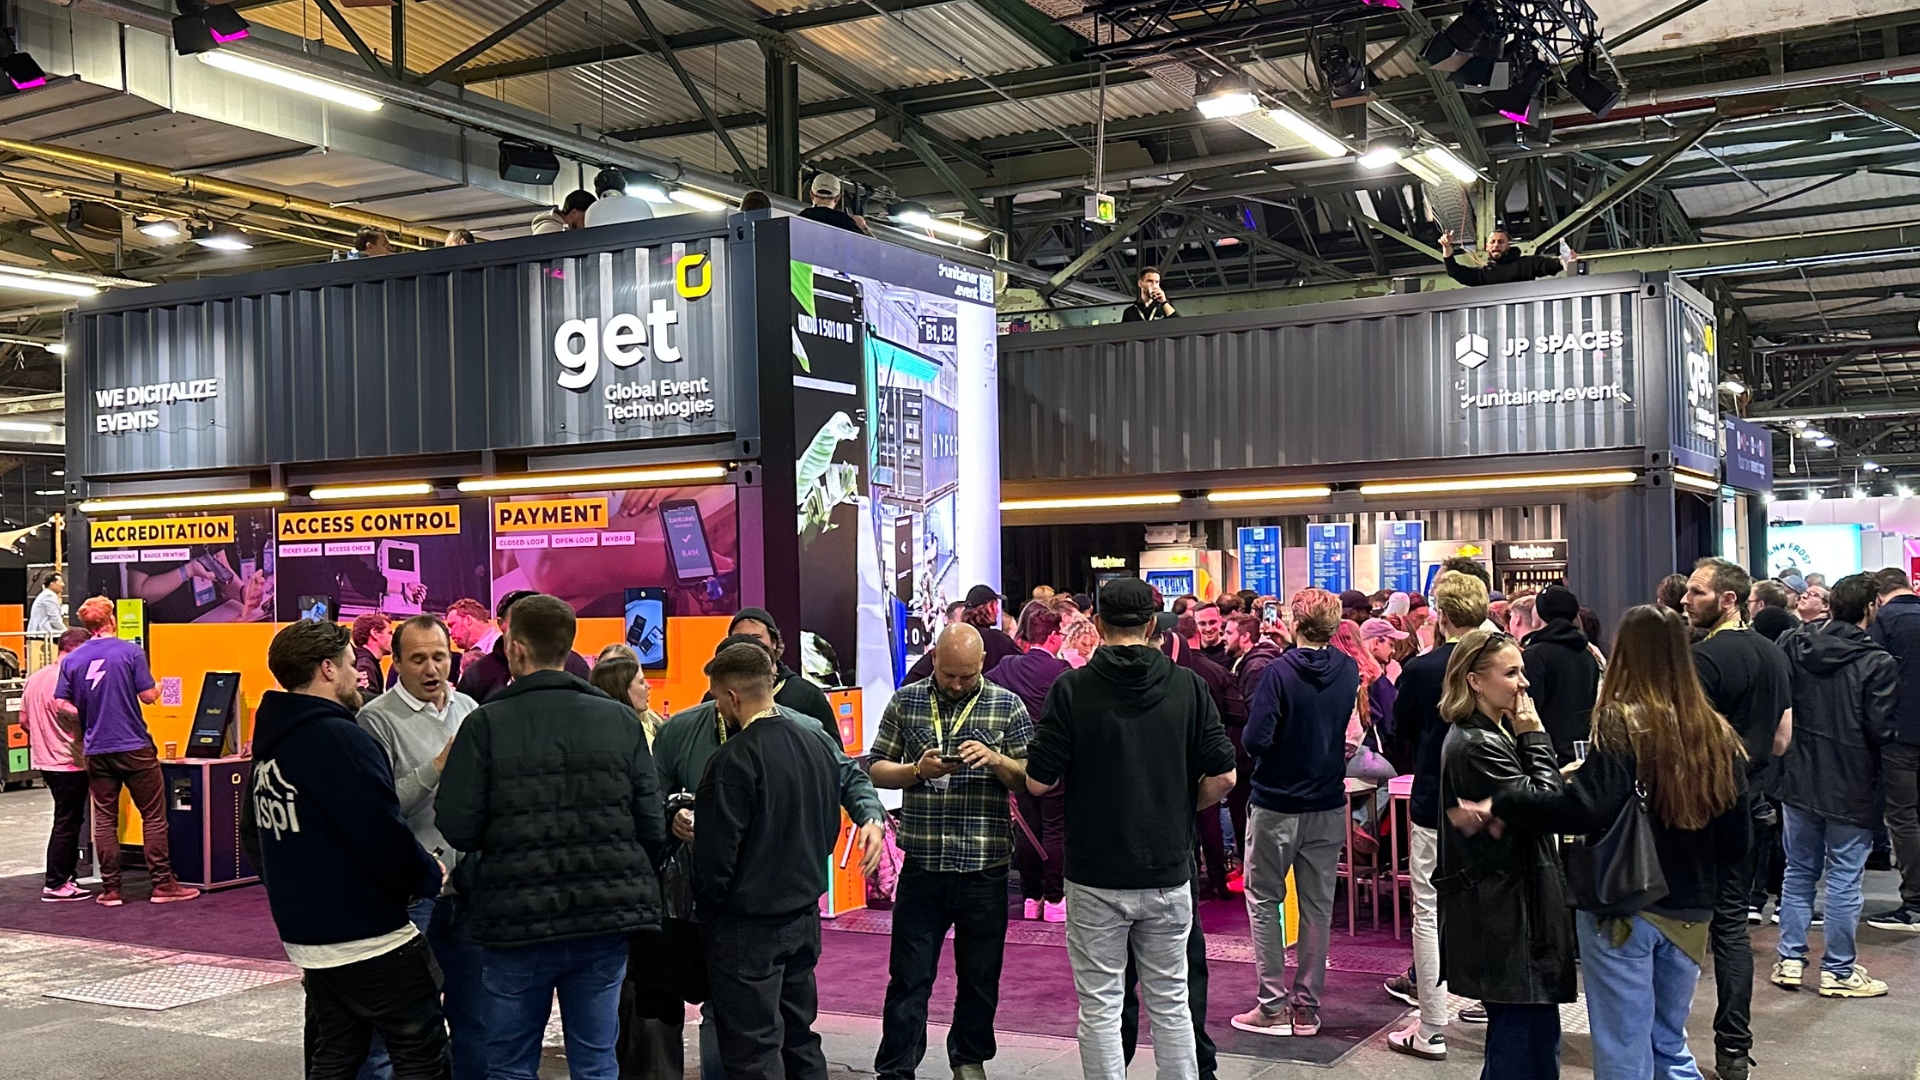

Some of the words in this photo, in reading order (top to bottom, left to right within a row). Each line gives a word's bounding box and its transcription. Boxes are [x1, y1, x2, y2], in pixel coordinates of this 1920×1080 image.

[554, 299, 681, 388] get
[926, 325, 940, 343] B1,
[941, 325, 955, 342] B2
[1501, 337, 1530, 357] JP
[1535, 329, 1624, 354] SPACES
[96, 388, 125, 408] WE
[127, 379, 217, 405] DIGITALIZE
[604, 380, 657, 400] Global
[661, 377, 710, 396] Event
[1476, 382, 1621, 408] unitainer.event
[604, 396, 715, 420] Technologies
[96, 409, 159, 432] EVENTS
[282, 516, 355, 535] ACCESS
[361, 512, 456, 532] CONTROL
[500, 504, 602, 525] PAYMENT
[94, 521, 229, 542] ACCREDITATION
[499, 538, 545, 546] CLOSED-LOOP
[1789, 542, 1811, 564] FROST
